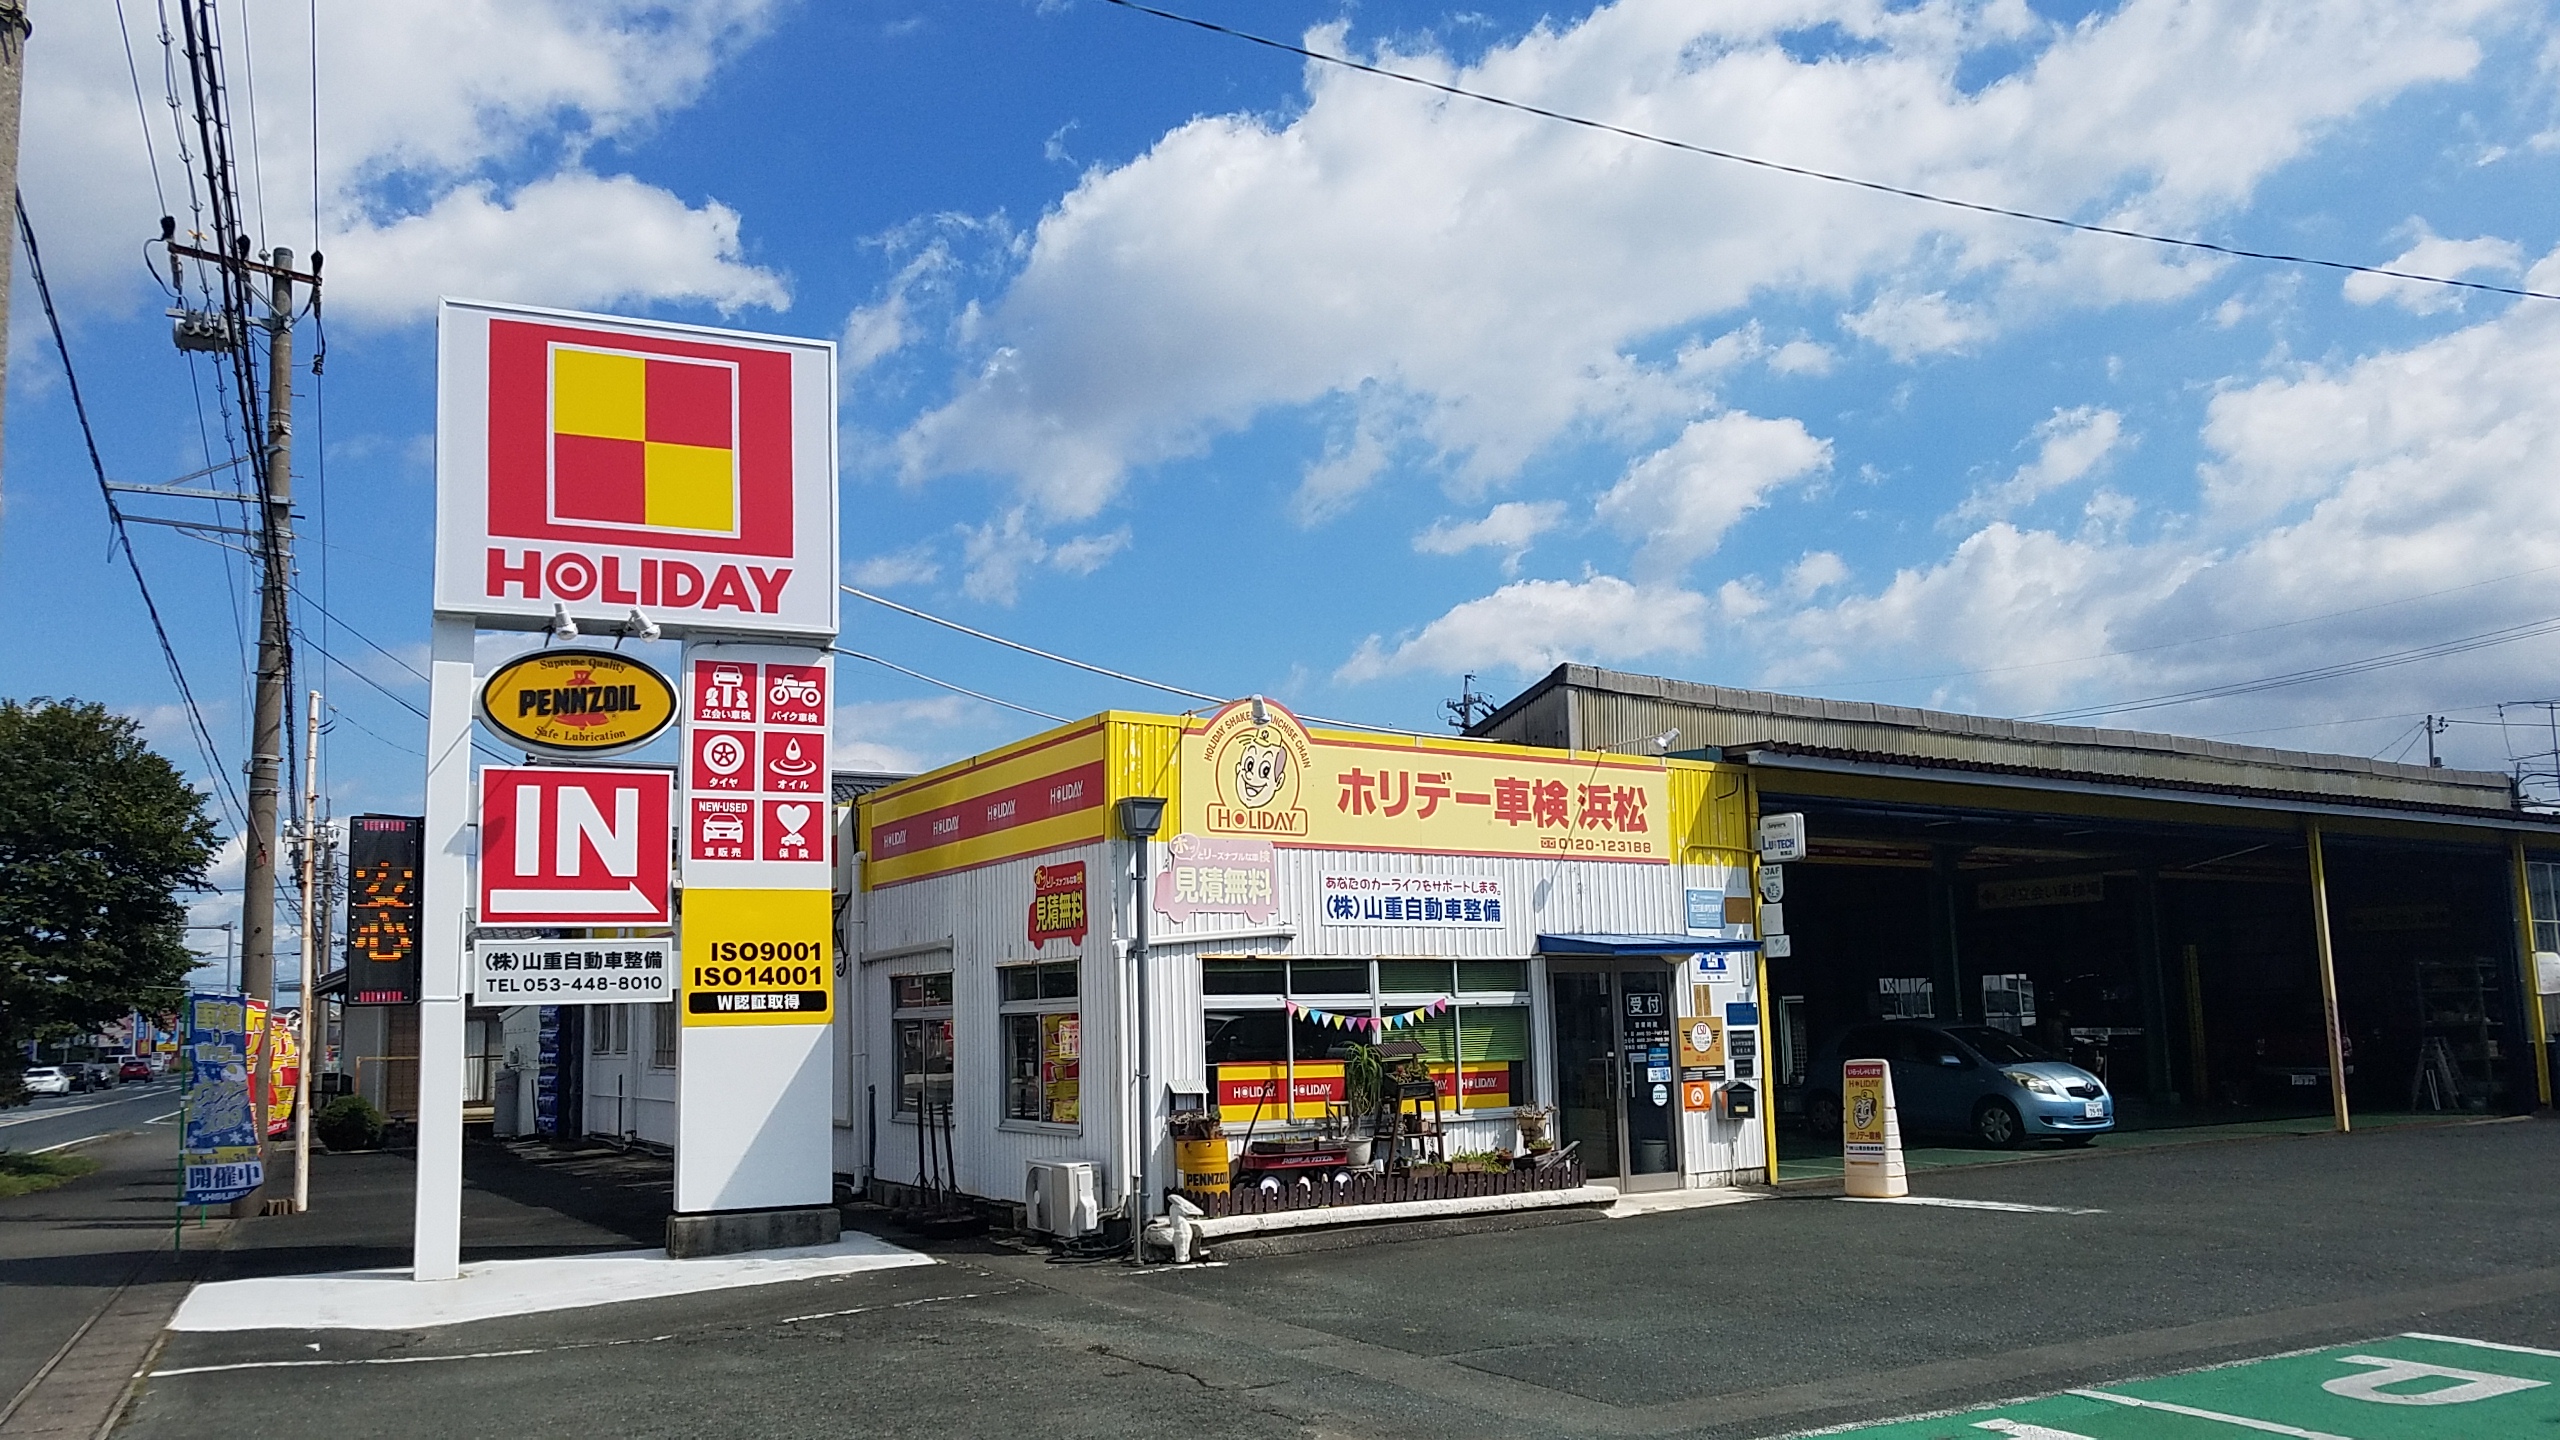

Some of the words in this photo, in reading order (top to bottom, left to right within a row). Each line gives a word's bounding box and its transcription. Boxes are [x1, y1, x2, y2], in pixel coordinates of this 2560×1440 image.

[486, 547, 794, 615] HOLIDAY
[540, 658, 586, 671] Supreme
[588, 657, 627, 674] Quality
[518, 685, 642, 719] PENNZOIL
[701, 709, 752, 721] 立会い車検
[771, 711, 818, 723] バイク車検
[534, 725, 559, 741] Safe
[564, 730, 627, 742] Lubrication
[1204, 725, 1228, 762] HOLIDAY
[1225, 711, 1253, 730] SHAKE
[1294, 739, 1311, 769] CHAIN
[709, 777, 738, 788] タイヤ
[778, 779, 809, 790] オイル
[932, 814, 960, 836] HOLIDAY
[987, 799, 1016, 822] HOLIDAY
[1049, 779, 1084, 805] HOLIDAY
[1217, 808, 1298, 832] HOLIDAY
[515, 784, 640, 877] IN
[1559, 838, 1652, 853] 0120-123188
[1764, 867, 1780, 875] JAF
[1173, 867, 1272, 906] 見積無料
[355, 861, 414, 961] 安心
[1035, 889, 1084, 932] 見積無料
[711, 942, 822, 962] ISO9001
[694, 965, 822, 987] ISO14001
[717, 993, 801, 1010] W認証取得
[1630, 996, 1659, 1014] 受付
[1847, 1068, 1881, 1076] いらっしゃいませ
[1292, 1083, 1332, 1097] HOLIDAY
[1461, 1077, 1497, 1090] HOLIDAY
[1848, 1080, 1880, 1088] HOLIDAY
[1848, 1131, 1882, 1140] ホリデー車検
[189, 1164, 260, 1189] 開催中
[1186, 1173, 1228, 1187] PENNZO
